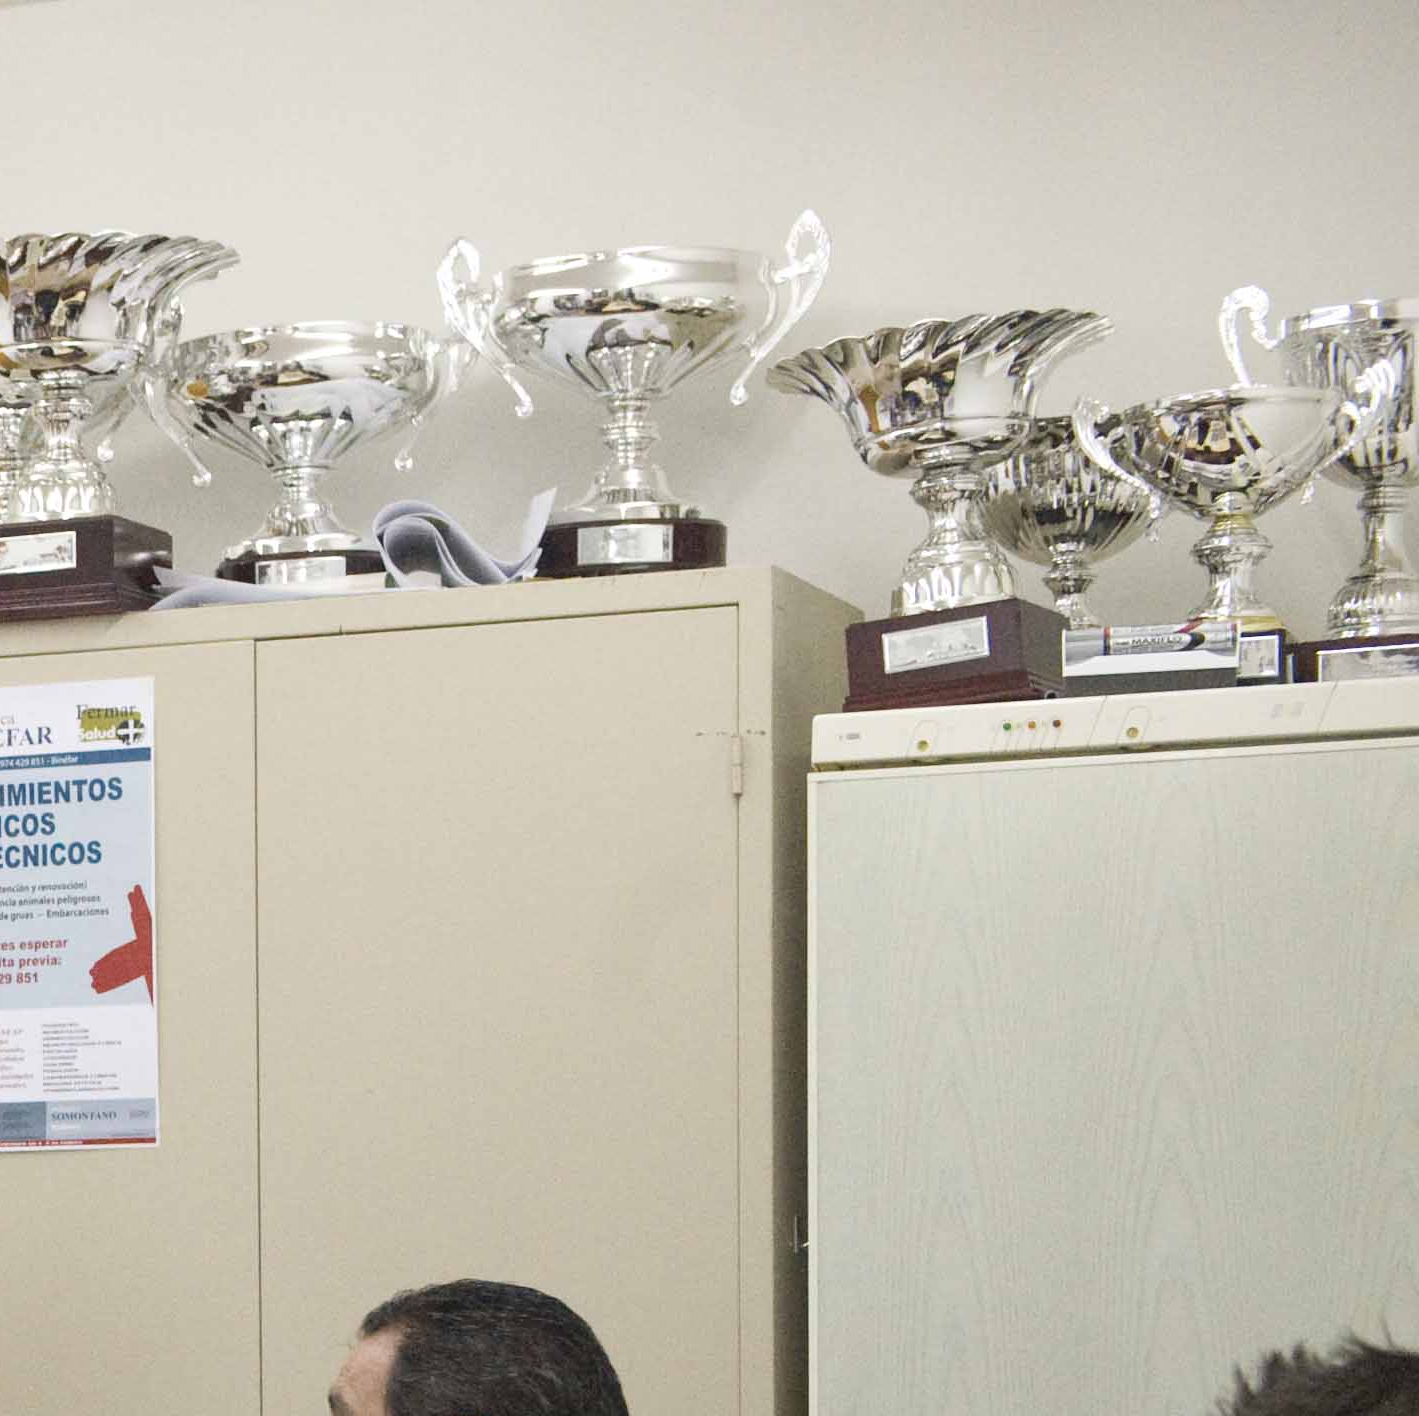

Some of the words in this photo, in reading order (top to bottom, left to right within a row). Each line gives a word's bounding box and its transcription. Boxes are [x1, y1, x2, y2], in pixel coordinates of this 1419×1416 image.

[76, 704, 137, 721] Fermar
[18, 897, 55, 907] animales
[57, 895, 101, 906] peligrosos
[46, 908, 109, 919] Embarcaciones
[19, 938, 68, 952] esperar
[18, 955, 62, 969] previa:
[16, 972, 39, 985] 851
[50, 1110, 117, 1122] SOMONTANO
